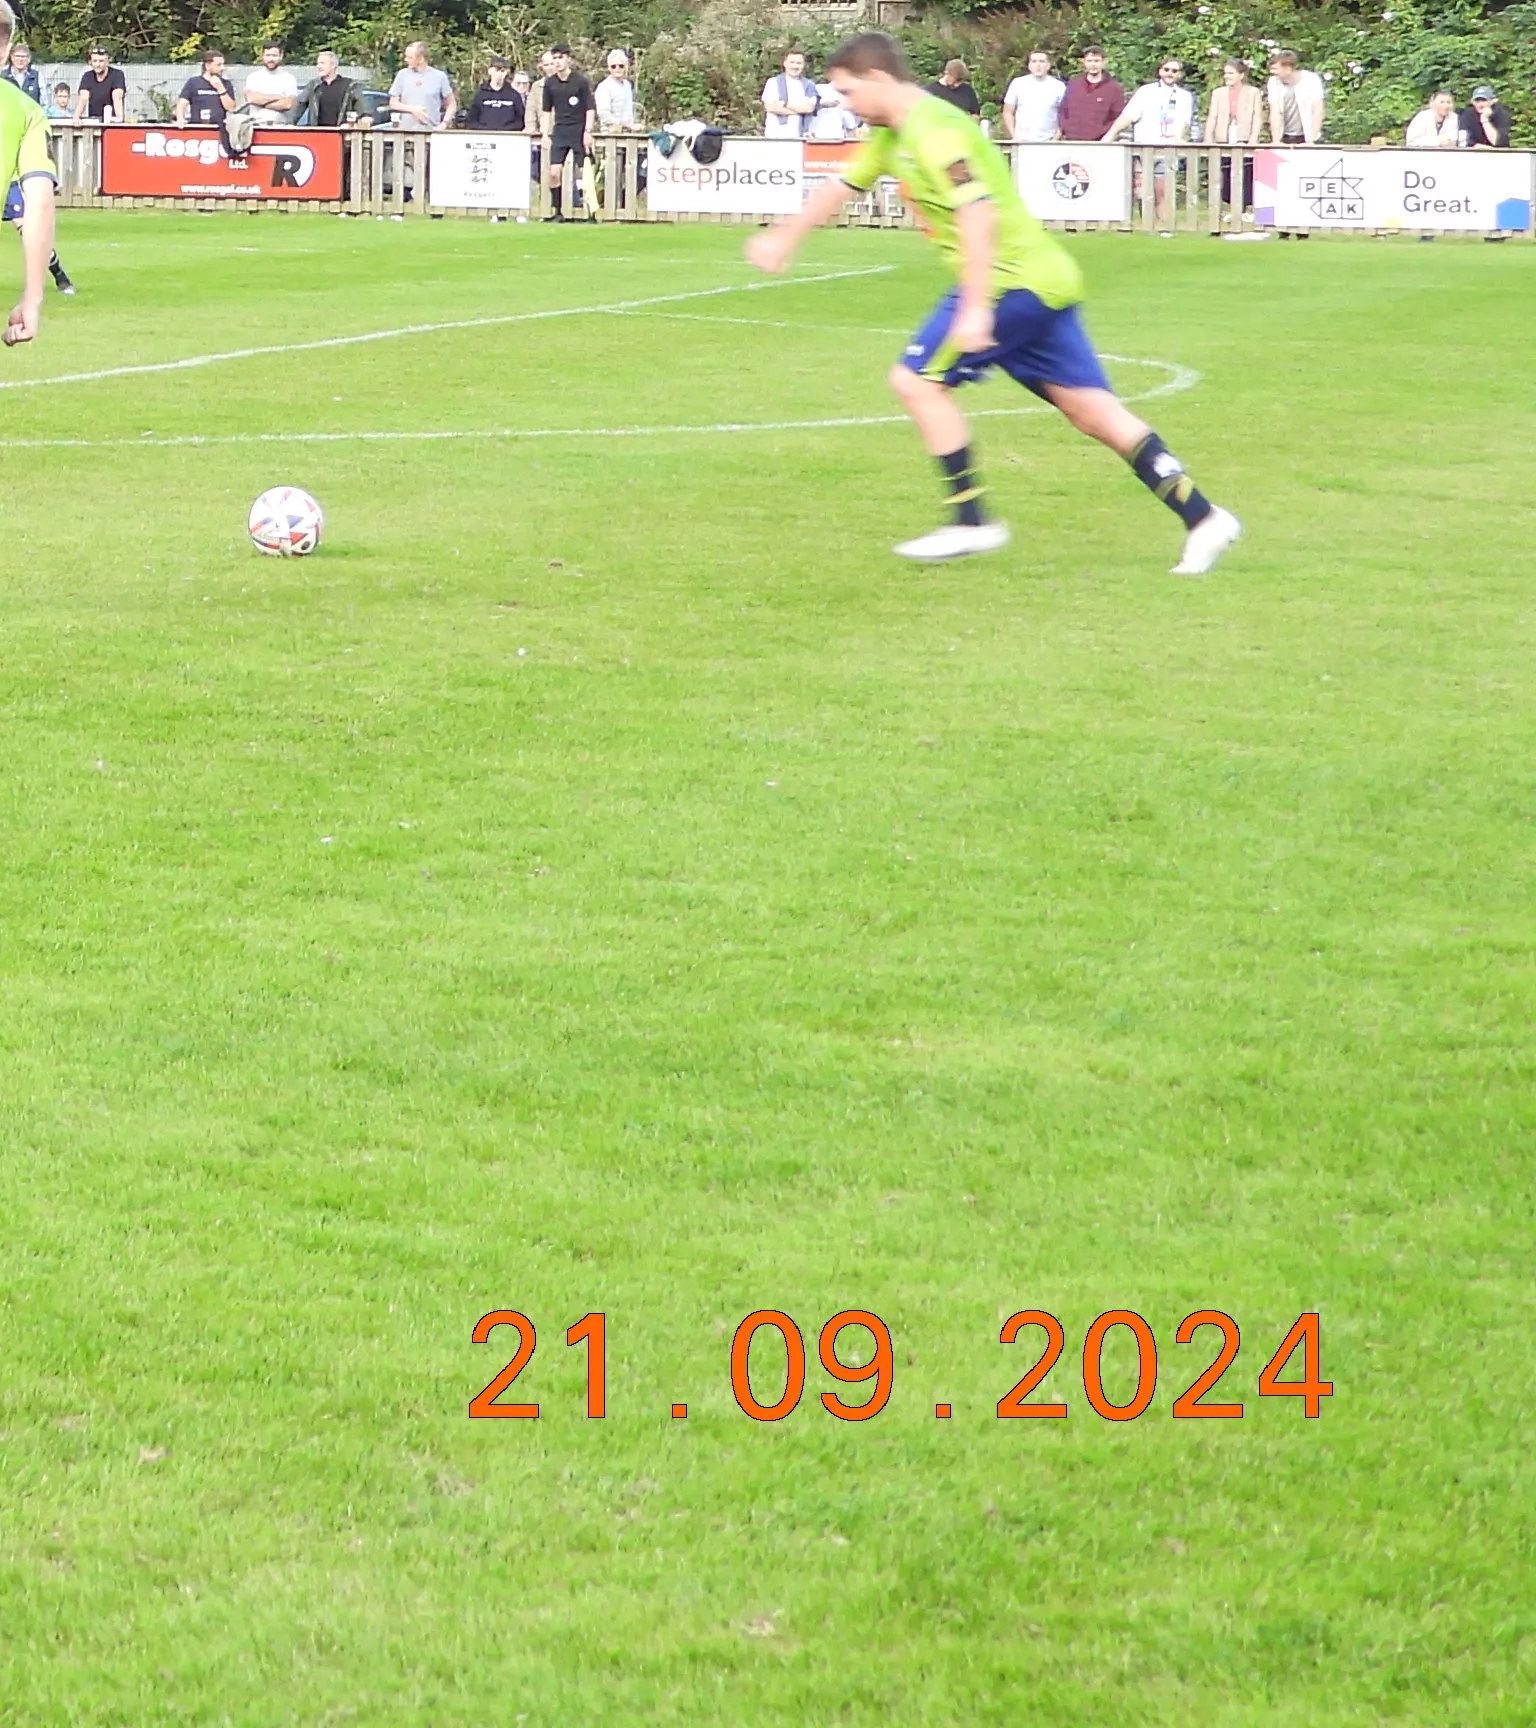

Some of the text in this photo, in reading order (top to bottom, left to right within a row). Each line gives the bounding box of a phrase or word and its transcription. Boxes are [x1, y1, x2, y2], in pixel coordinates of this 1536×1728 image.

[657, 162, 796, 191] stepplaces
[1404, 171, 1436, 189] Do
[1403, 194, 1478, 213] Great.
